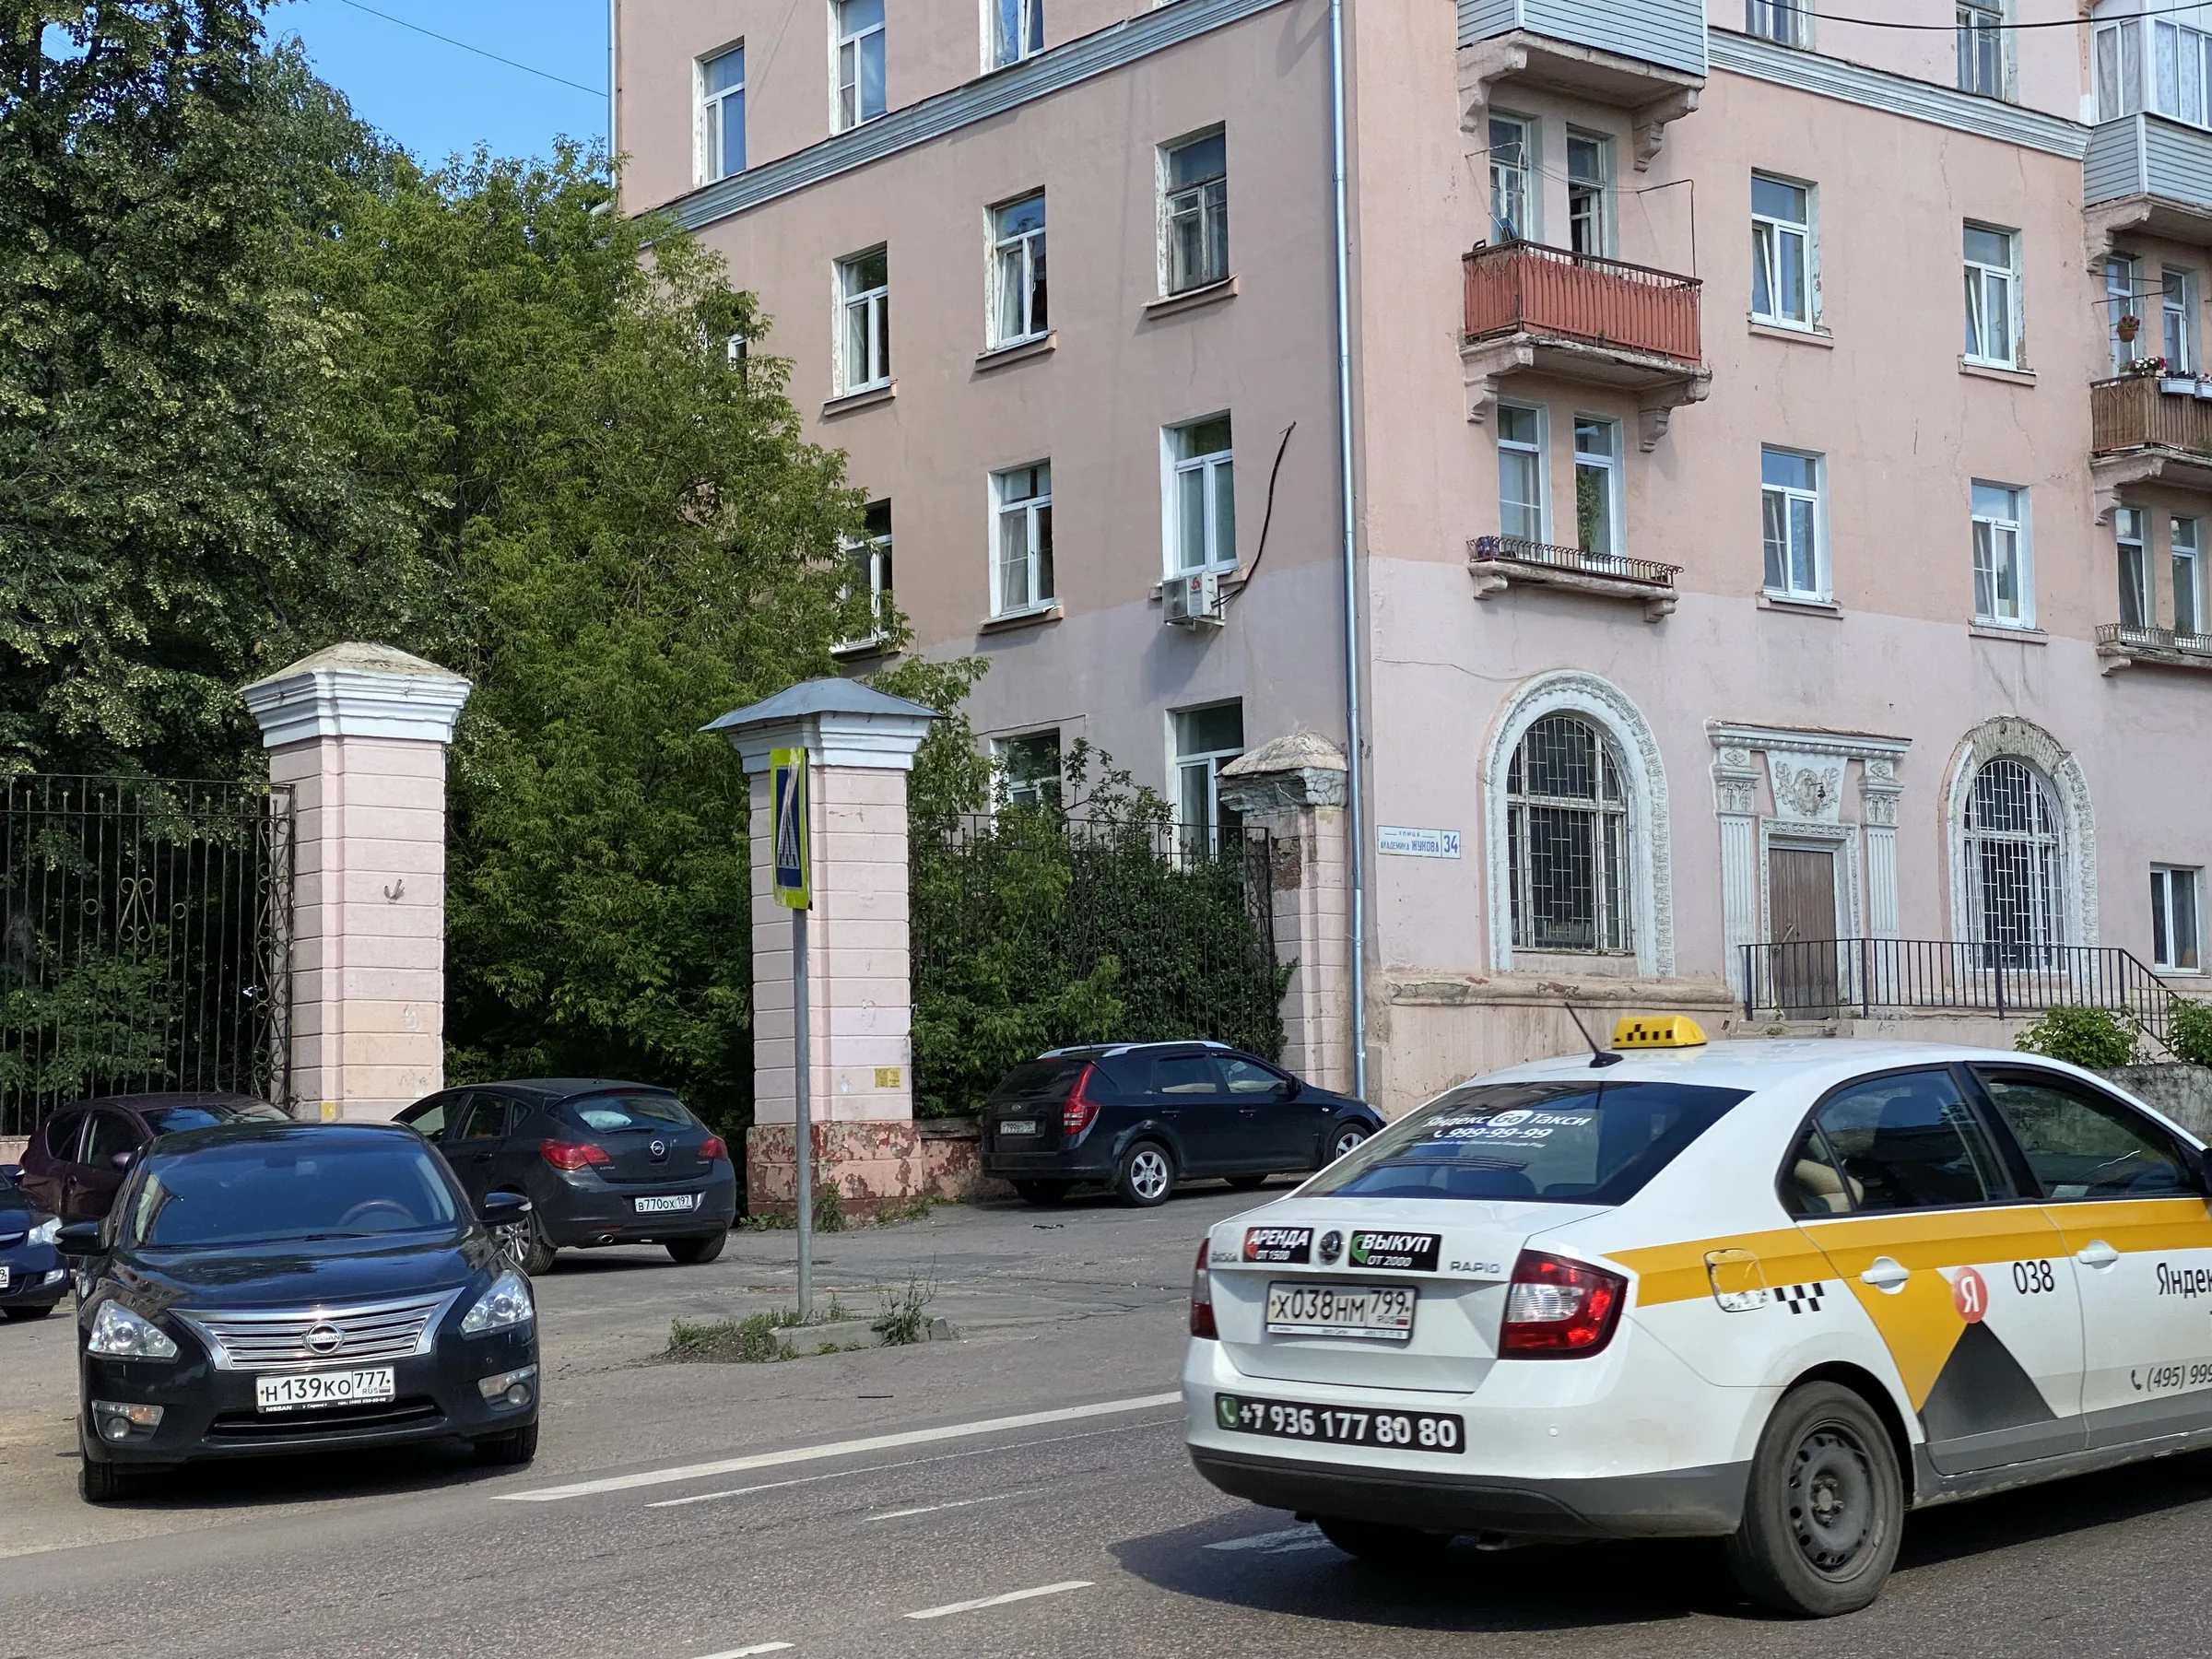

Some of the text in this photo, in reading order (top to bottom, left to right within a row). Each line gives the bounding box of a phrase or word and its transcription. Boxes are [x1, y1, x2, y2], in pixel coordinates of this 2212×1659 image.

[1381, 840, 1440, 853] АКАДЕМИКА ЖУКОВА
[1443, 834, 1458, 853] 34
[1422, 1115, 1492, 1128] Яндекс
[1526, 1113, 1592, 1126] Такси
[1443, 1127, 1554, 1139] 999-99-99
[1248, 1230, 1310, 1246] АРЕНДА
[1360, 1234, 1432, 1253] ВЫКУП
[1255, 1250, 1290, 1261] ОТ 1500
[1367, 1255, 1412, 1267] ОТ 2000
[1450, 1261, 1501, 1274] RAPID
[2013, 1259, 2054, 1294] 038
[1960, 1276, 1980, 1313] Я
[1275, 1288, 1406, 1323] Х038НМ 799
[265, 1371, 386, 1402] Н139КО 777
[2147, 1365, 2185, 1393] (495)
[265, 1405, 292, 1413] NISSAN
[1240, 1403, 1457, 1448] +7 936 177 80 80
